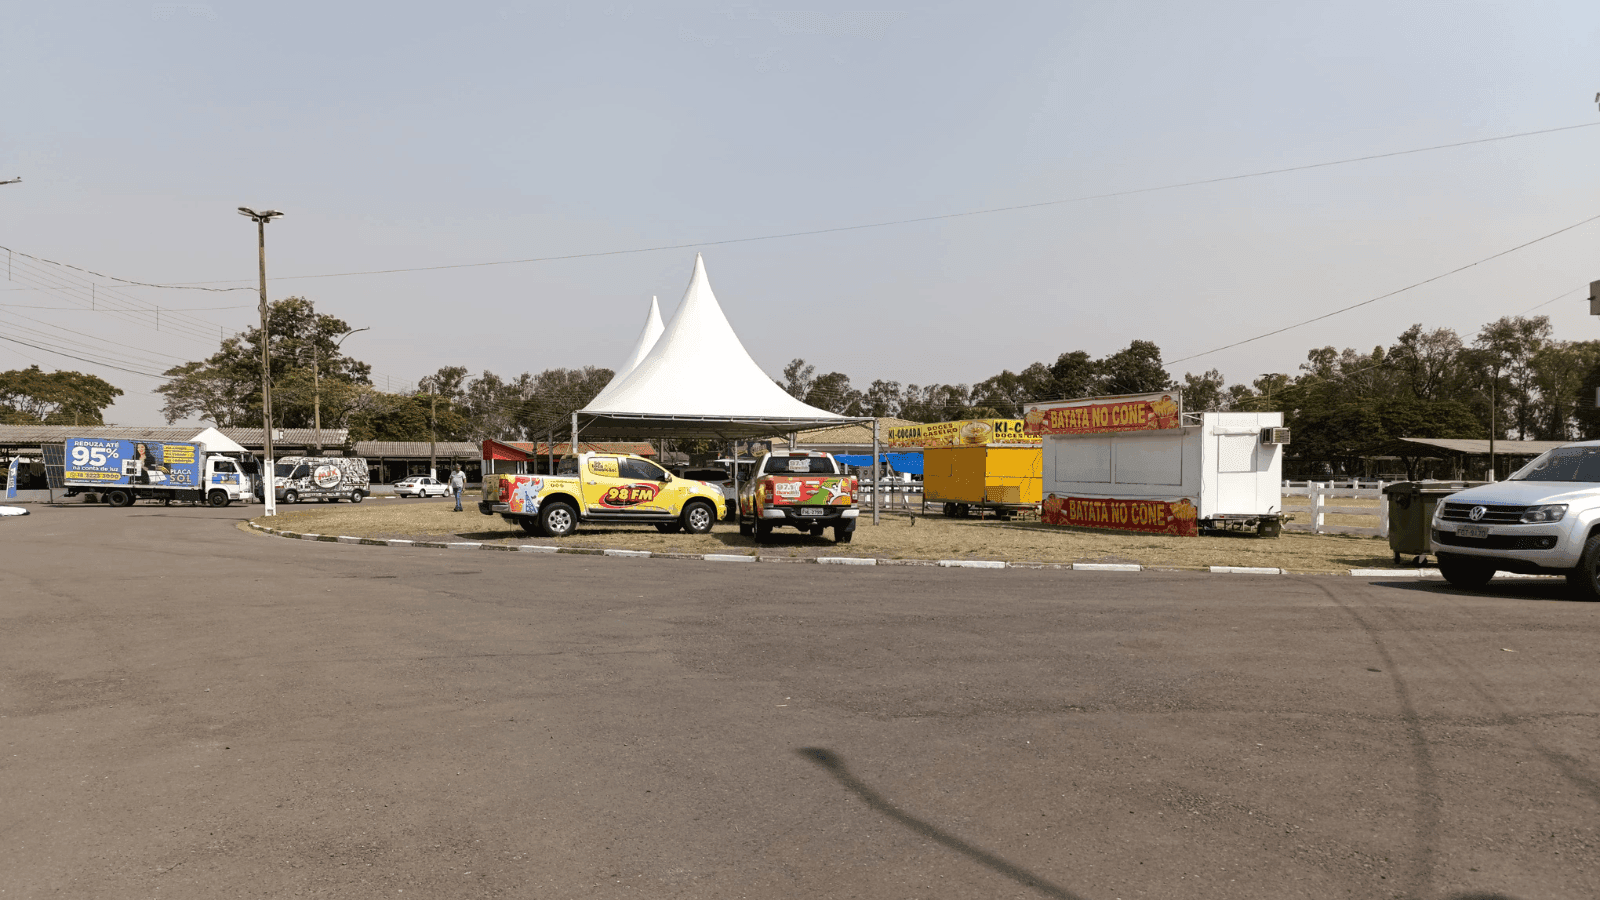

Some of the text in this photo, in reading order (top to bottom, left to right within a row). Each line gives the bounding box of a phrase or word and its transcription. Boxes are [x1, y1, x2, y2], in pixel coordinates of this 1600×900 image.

[1051, 404, 1145, 428] BATATA NO CONE
[927, 423, 952, 431] DOCES
[995, 422, 1025, 433] KI-C
[72, 446, 119, 467] 95%
[609, 489, 653, 500] 98 FM
[1069, 500, 1165, 526] BATATA NO CONE
